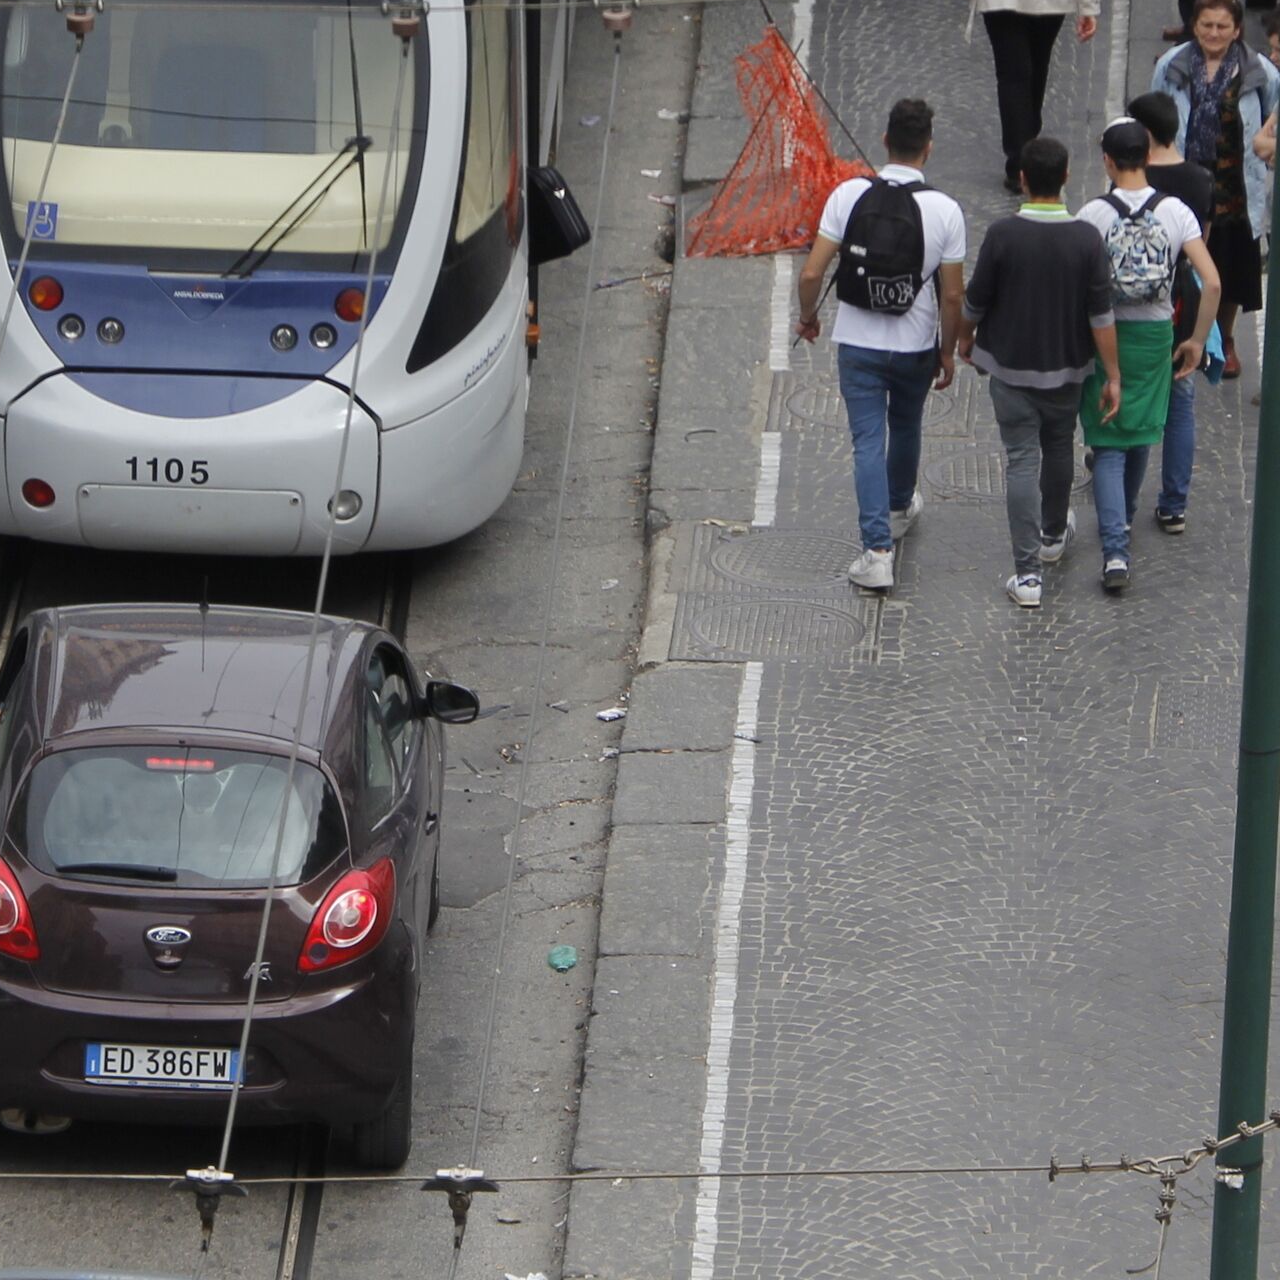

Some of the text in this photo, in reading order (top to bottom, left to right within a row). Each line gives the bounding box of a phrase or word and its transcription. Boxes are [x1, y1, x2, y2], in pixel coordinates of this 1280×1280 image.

[125, 456, 210, 485] 1105
[103, 1047, 228, 1078] ED 386FW
